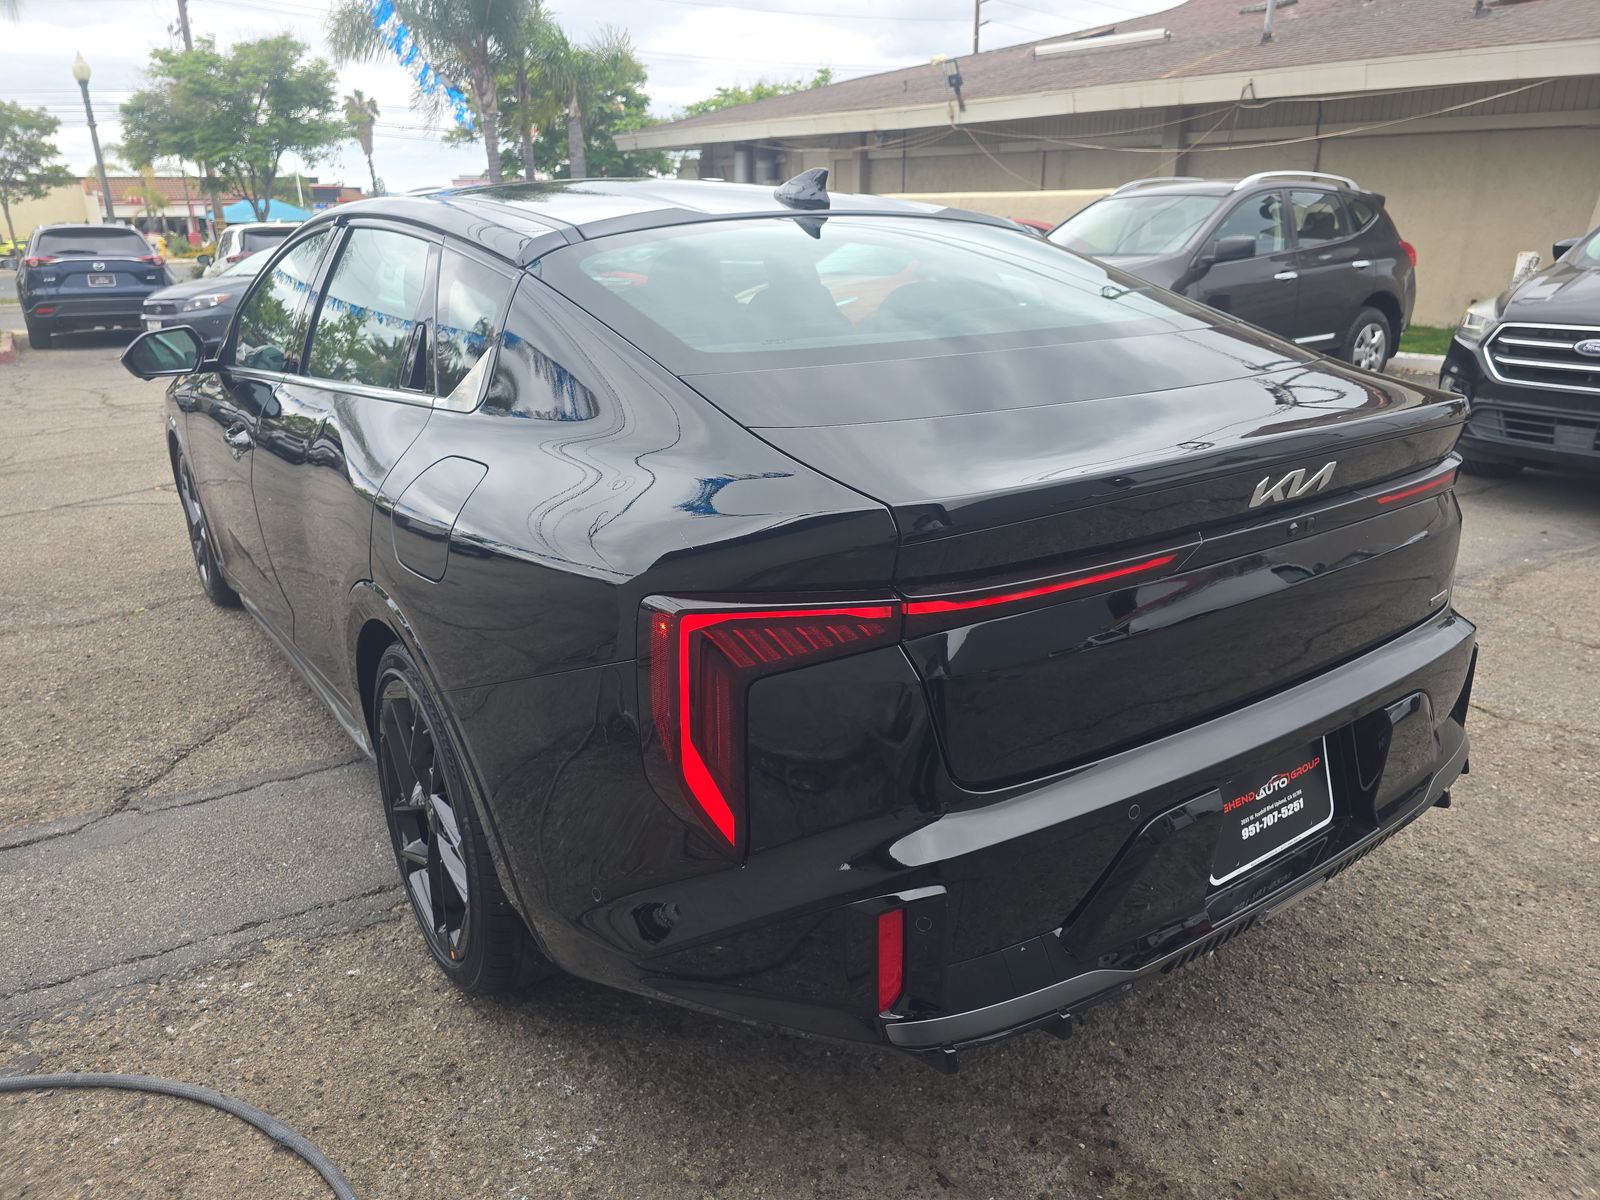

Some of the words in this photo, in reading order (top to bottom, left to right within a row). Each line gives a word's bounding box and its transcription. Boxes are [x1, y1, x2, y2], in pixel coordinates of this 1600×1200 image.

[1248, 461, 1337, 508] KIA
[1255, 777, 1288, 800] AUTO
[1291, 757, 1321, 780] GROUP
[1241, 797, 1304, 840] 951-707-5251
